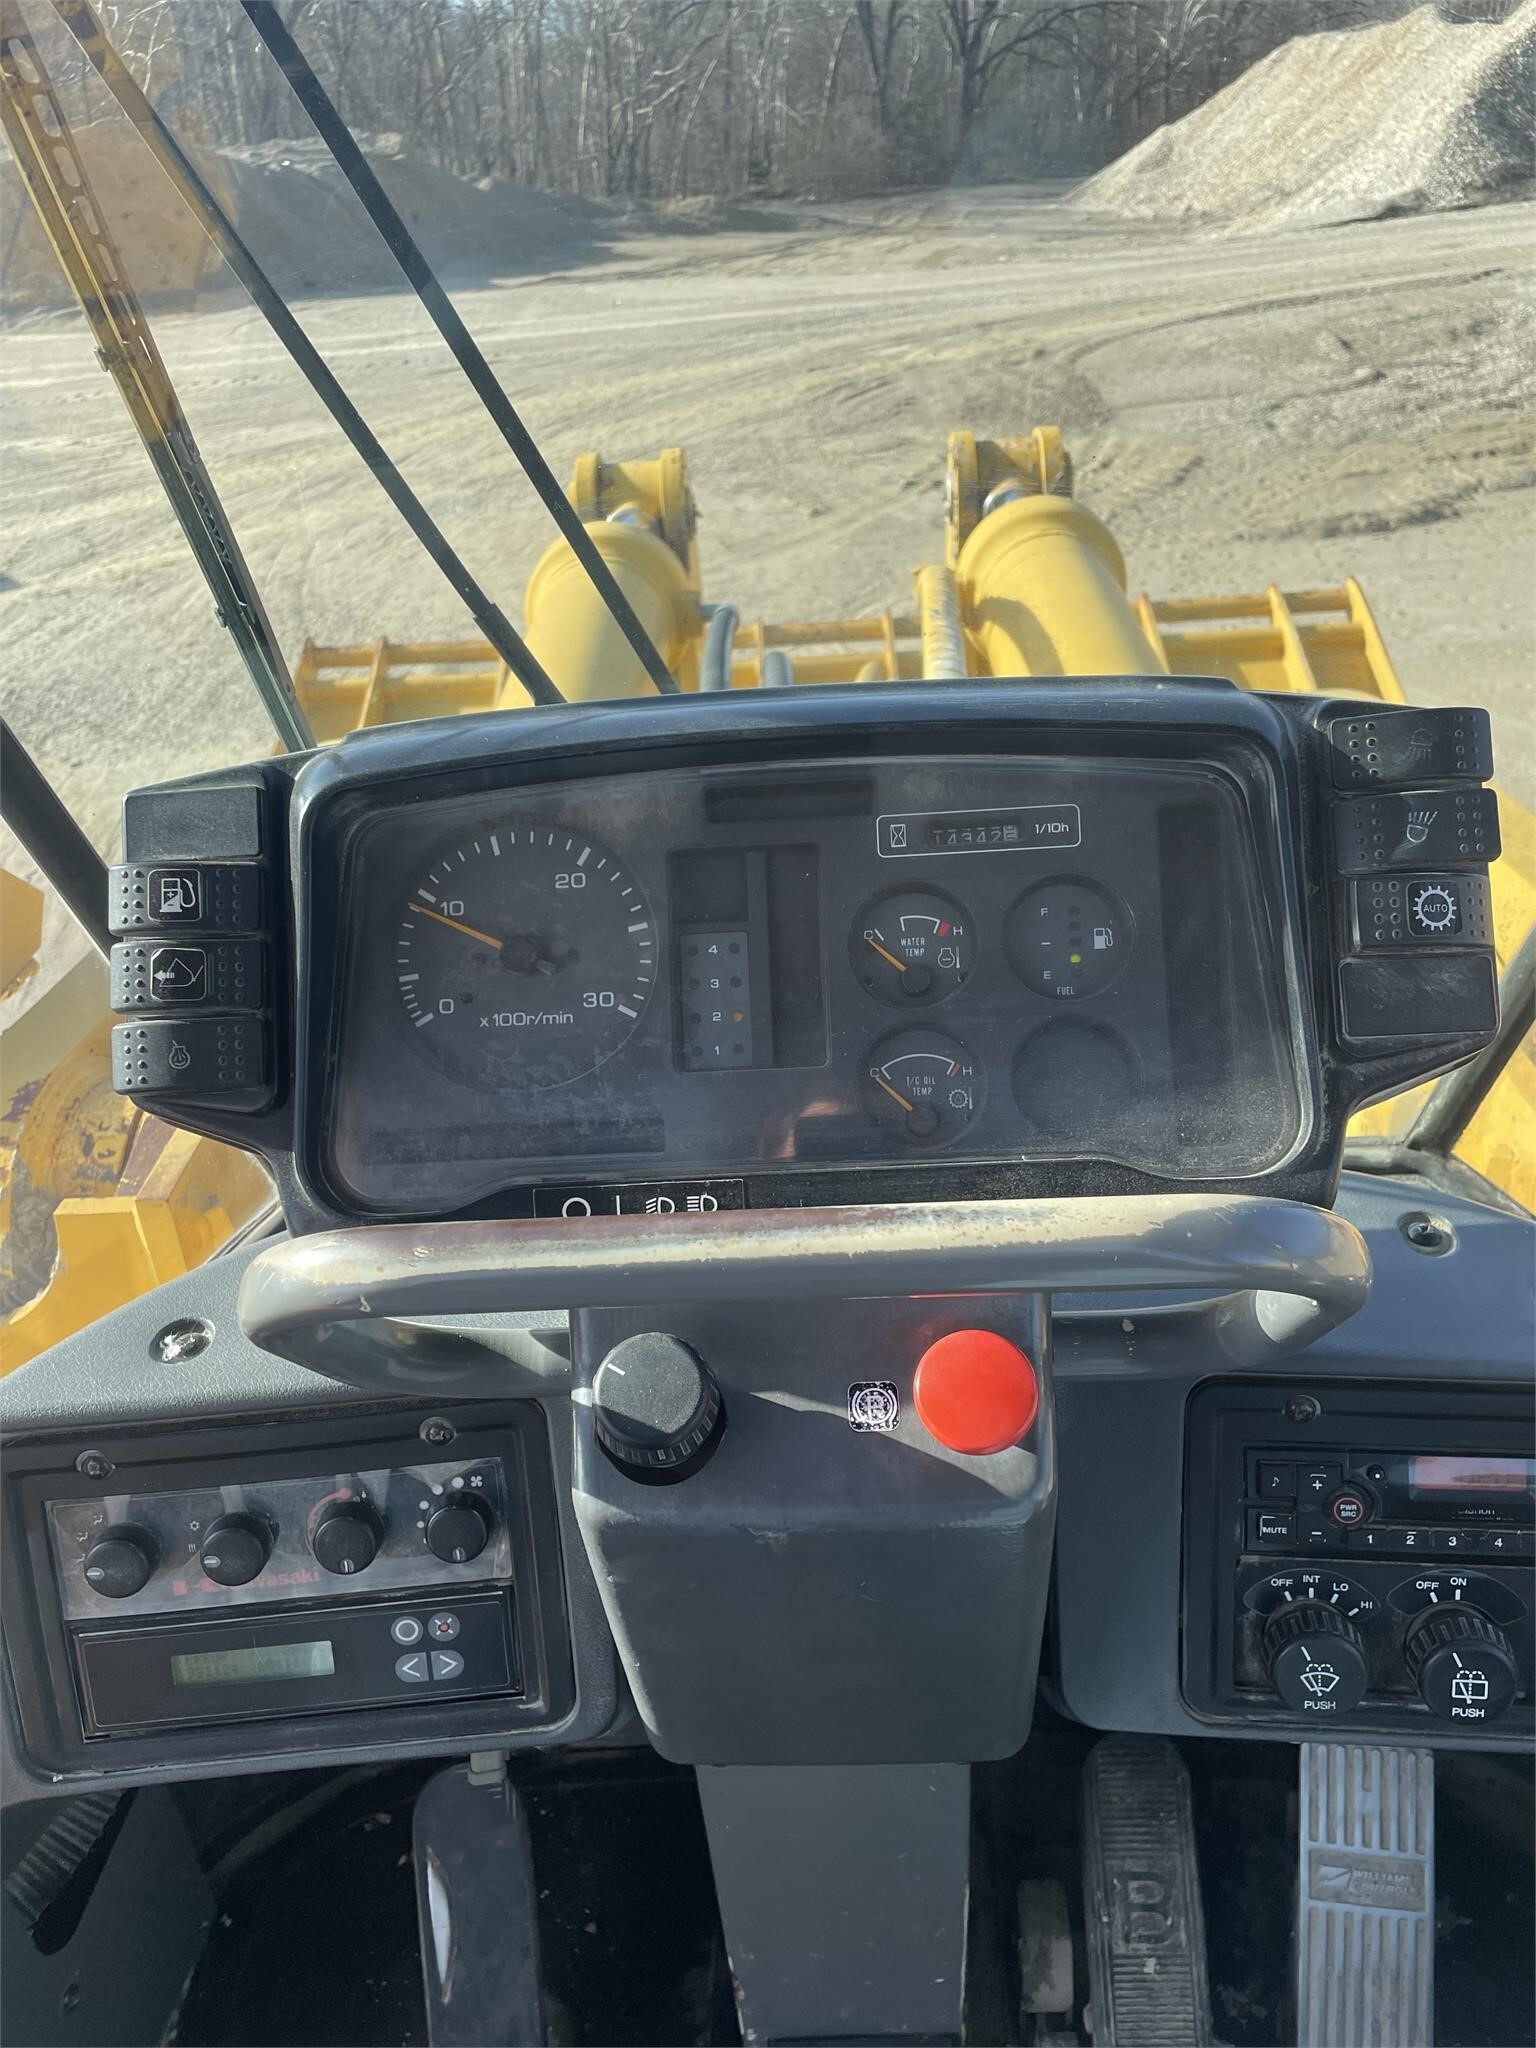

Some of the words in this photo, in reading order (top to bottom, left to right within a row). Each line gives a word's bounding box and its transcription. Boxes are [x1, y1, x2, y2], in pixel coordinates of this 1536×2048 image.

[1034, 822, 1070, 834] 1/10h
[554, 872, 587, 889] 20
[439, 900, 465, 917] 10
[1040, 907, 1049, 917] F
[1423, 903, 1448, 913] AUTO
[863, 929, 874, 940] C
[953, 925, 963, 936] H
[900, 937, 926, 947] WATER
[708, 944, 718, 954] 4
[905, 948, 925, 957] TEMP
[1043, 970, 1052, 980] E
[710, 978, 720, 989] 3
[1056, 986, 1075, 995] FUEL
[582, 991, 615, 1008] 30
[438, 998, 455, 1015] 0
[712, 1011, 721, 1022] 2
[713, 1045, 720, 1056] 1
[869, 1067, 880, 1078] C
[962, 1066, 972, 1076] H
[912, 1087, 933, 1096] TEMP
[1262, 1525, 1288, 1534] MUTE
[1366, 1534, 1374, 1544] 1
[1405, 1535, 1415, 1545] 2
[1448, 1536, 1457, 1546] 3
[1494, 1537, 1503, 1547] 4
[1415, 1580, 1439, 1590] OFF
[1450, 1576, 1467, 1586] ON
[1270, 1578, 1293, 1587] OFF
[1302, 1574, 1320, 1583] INT
[1332, 1582, 1349, 1591] LO
[1360, 1600, 1373, 1609] HI
[1304, 1700, 1336, 1710] PUSH
[1451, 1708, 1485, 1718] PUSH
